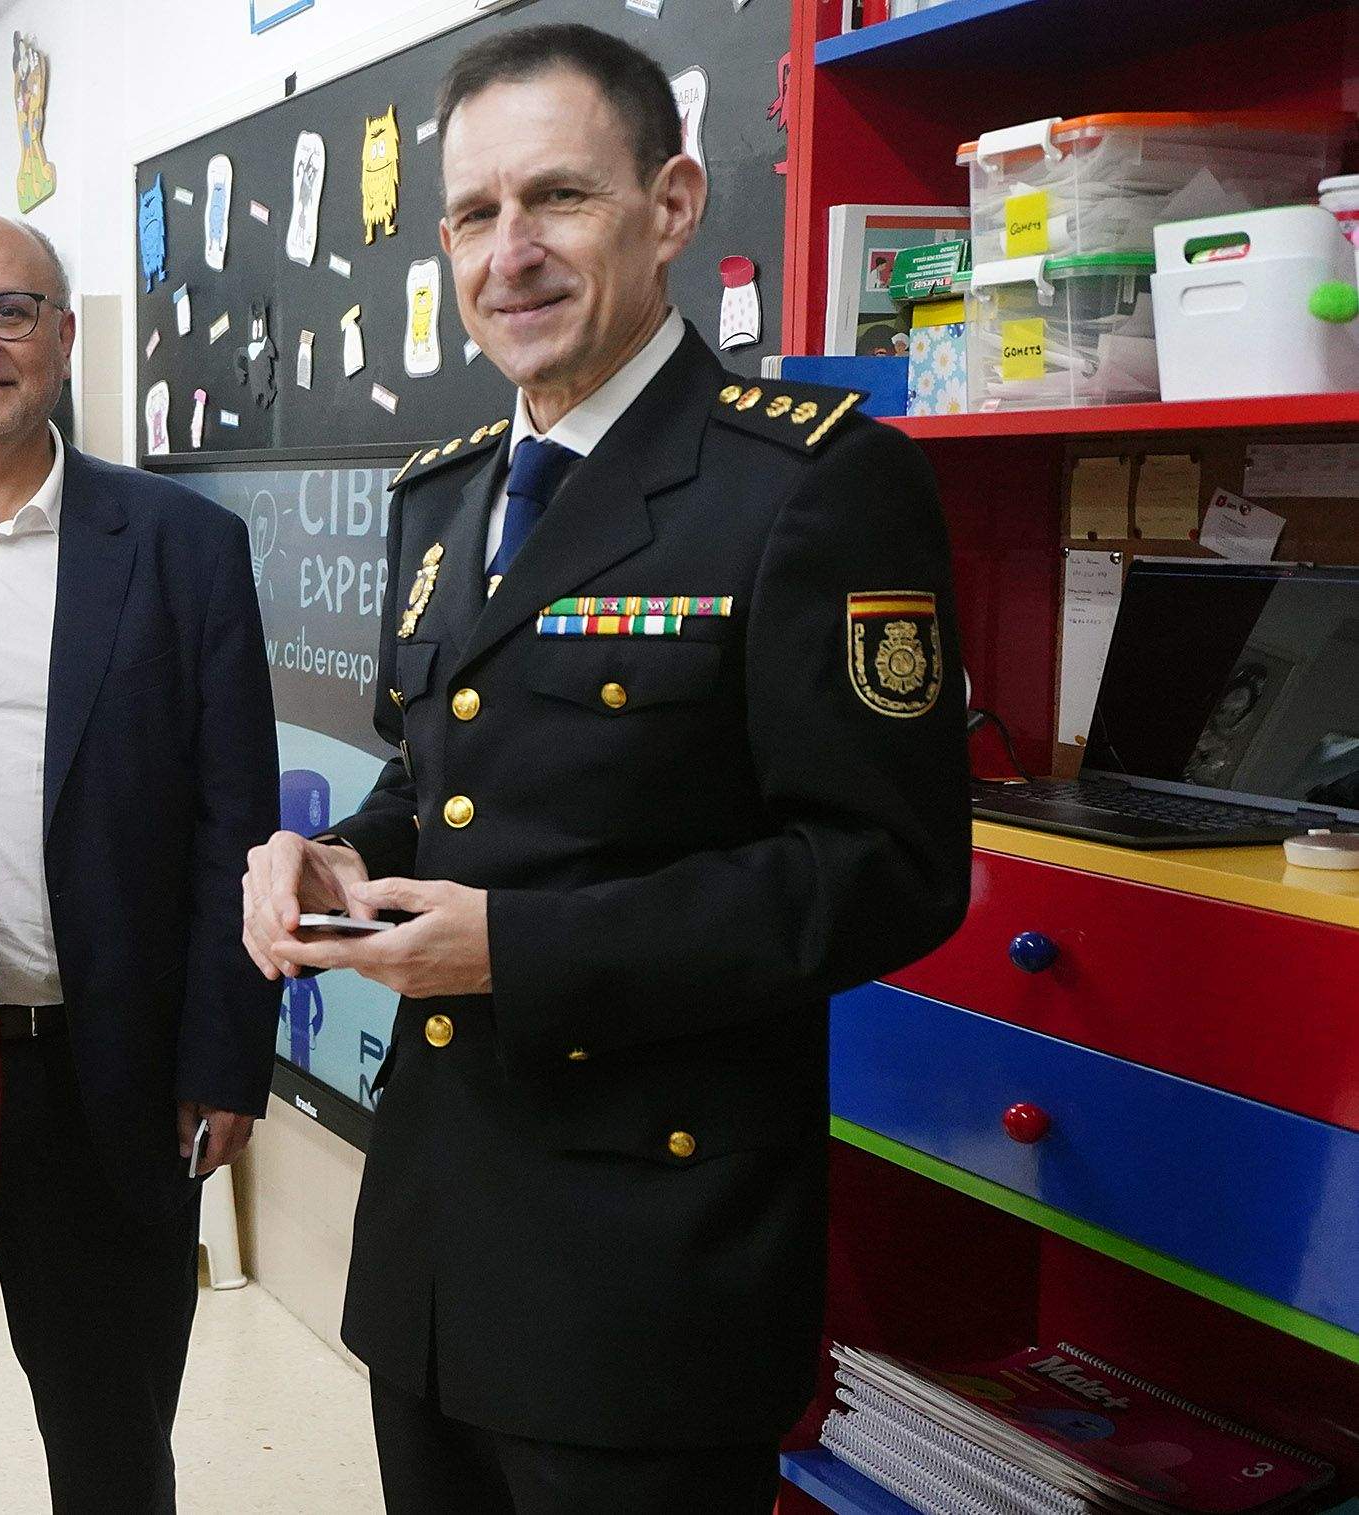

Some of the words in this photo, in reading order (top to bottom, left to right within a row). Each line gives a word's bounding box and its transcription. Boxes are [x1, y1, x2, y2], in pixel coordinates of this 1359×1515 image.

[300, 554, 389, 616] EXPER
[266, 625, 380, 697] w.ciberexp
[1242, 1462, 1274, 1478] 3
